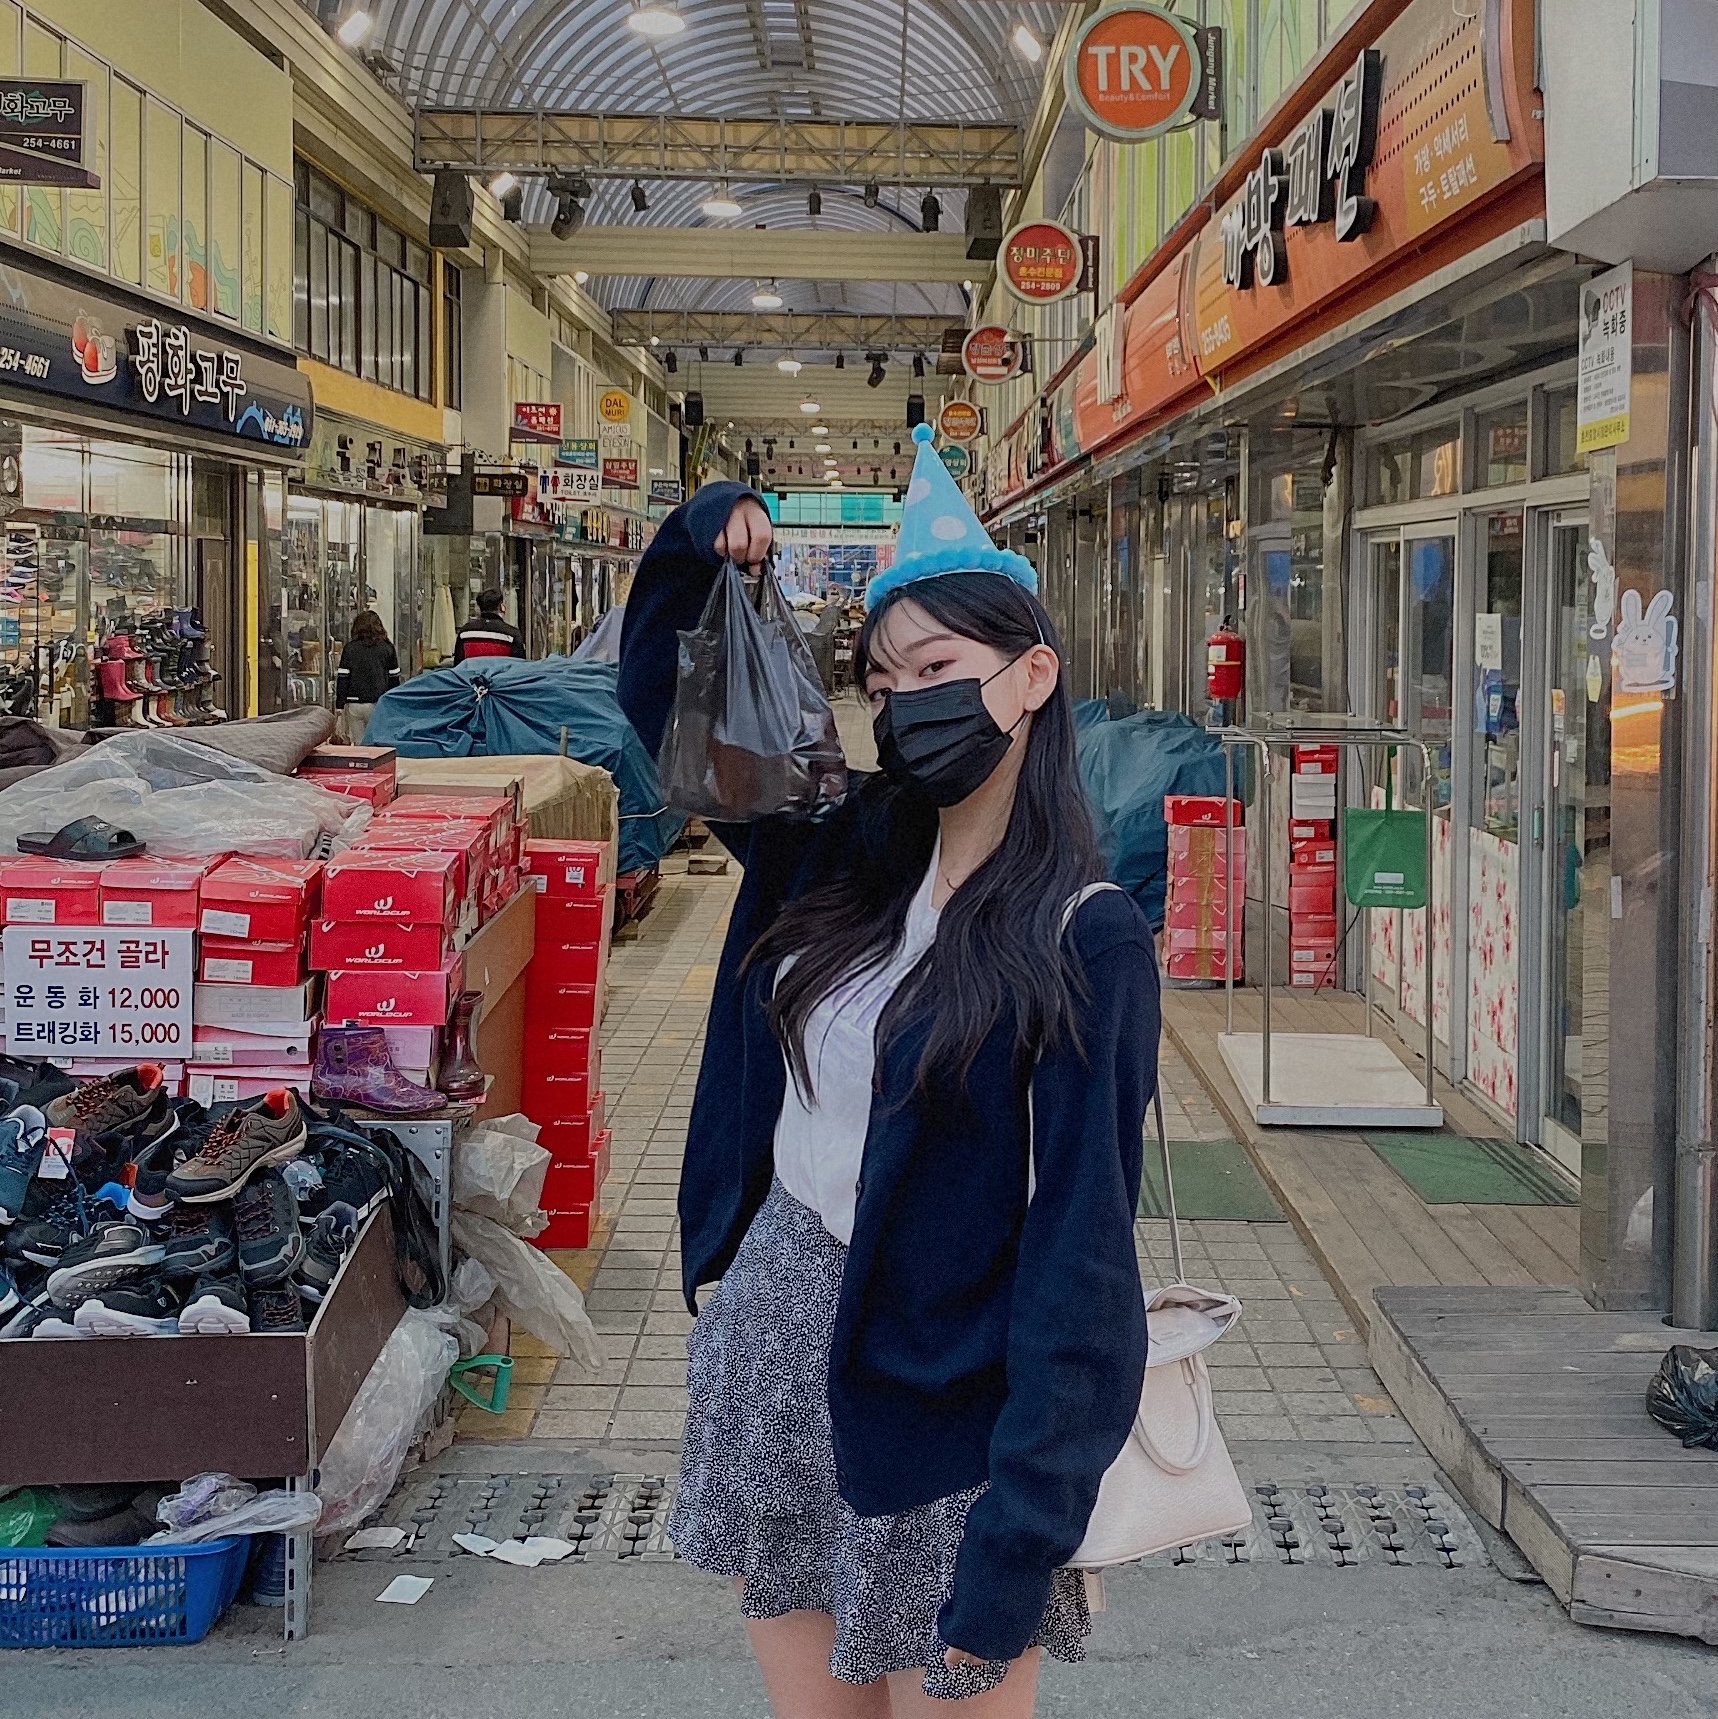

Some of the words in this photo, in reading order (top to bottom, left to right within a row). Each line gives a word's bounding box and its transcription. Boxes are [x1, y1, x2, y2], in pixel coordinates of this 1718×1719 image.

[1088, 44, 1182, 91] TRY
[0, 91, 75, 122] 화고무
[23, 138, 76, 149] 254-4661
[0, 167, 21, 175] arket
[1603, 283, 1626, 313] CCTV
[0, 346, 51, 379] 254-4661
[606, 398, 624, 408] DAL
[563, 473, 599, 491] 화장실
[28, 939, 106, 969] 무조건
[117, 939, 170, 970] 골라
[108, 987, 181, 1012] 12,000
[14, 1022, 101, 1046] 트래킹화
[108, 1023, 181, 1047] 15,000
